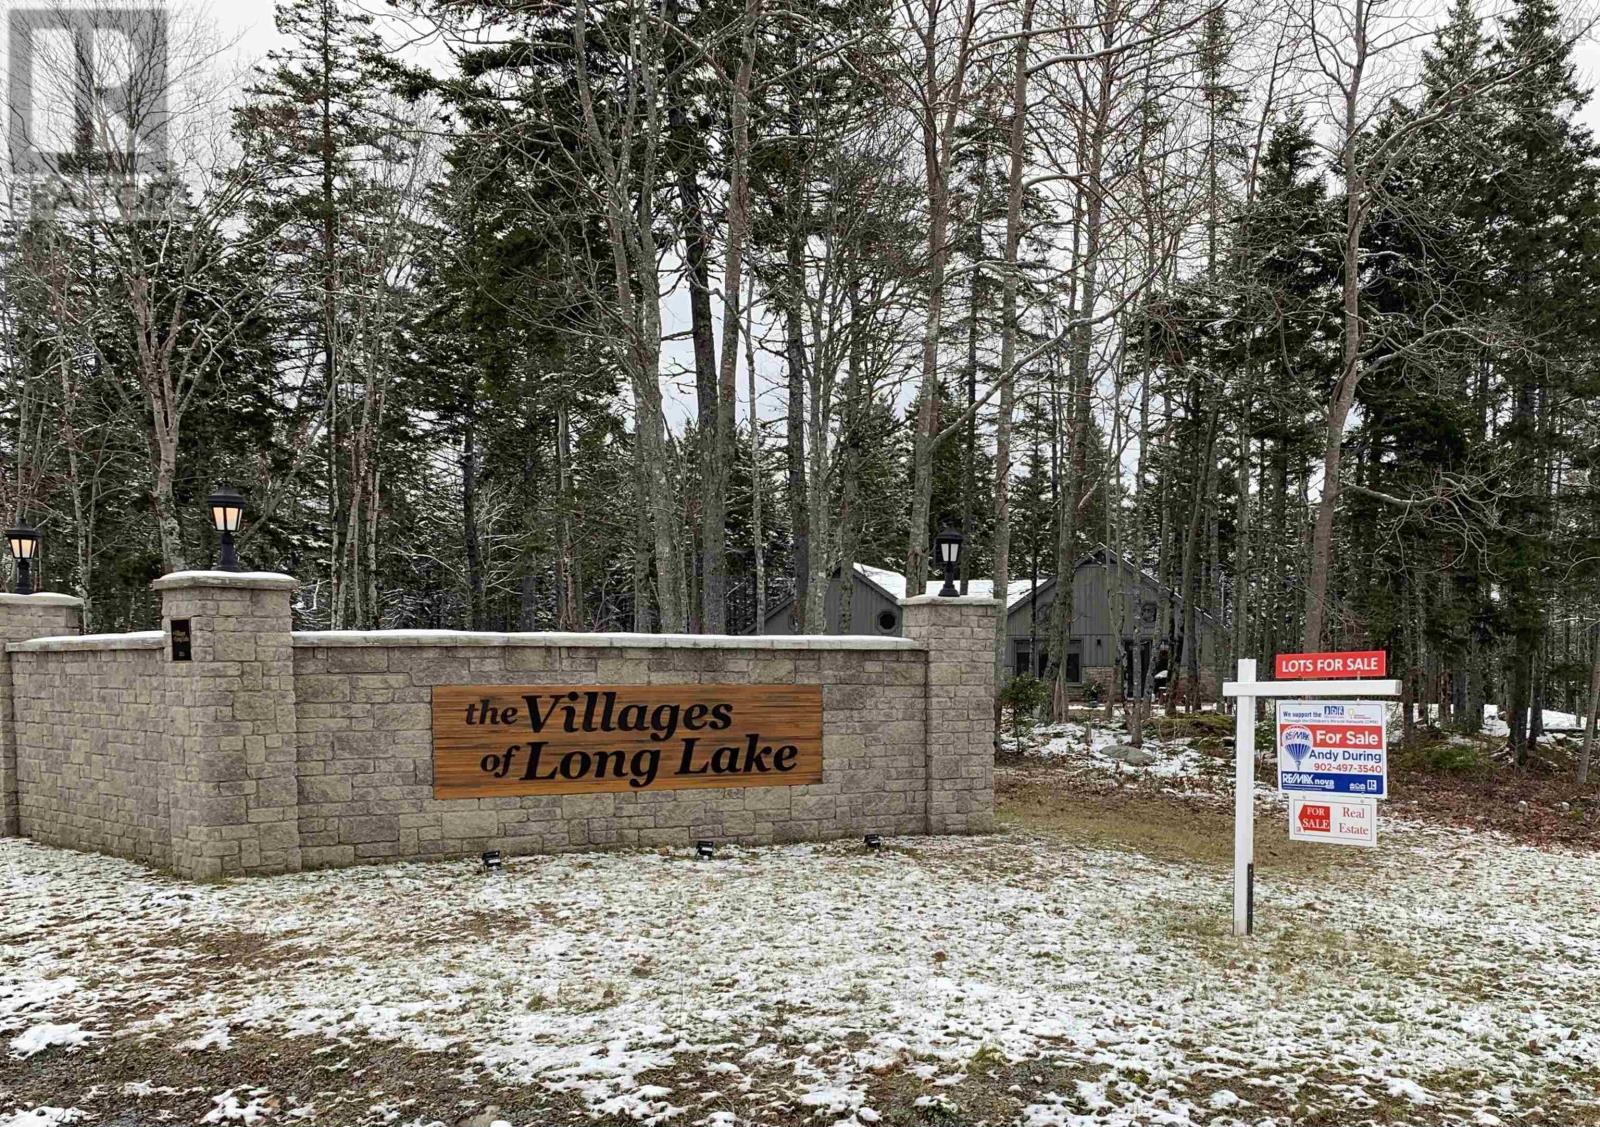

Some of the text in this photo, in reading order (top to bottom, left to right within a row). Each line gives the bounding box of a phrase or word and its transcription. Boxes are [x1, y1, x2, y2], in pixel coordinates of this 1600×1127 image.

[1282, 658, 1378, 672] LOTS FOR SALE
[465, 691, 733, 742] the Villages
[1294, 711, 1312, 719] support
[1316, 730, 1378, 745] For Sale
[479, 734, 798, 788] of Long Lake
[1309, 750, 1381, 763] Andy During
[1314, 763, 1381, 774] 902-497-3540
[1283, 773, 1314, 785] RE/MAX
[1307, 807, 1325, 816] FOR
[1343, 807, 1365, 819] Real
[1302, 818, 1330, 829] SALE
[1339, 823, 1369, 835] Estate
